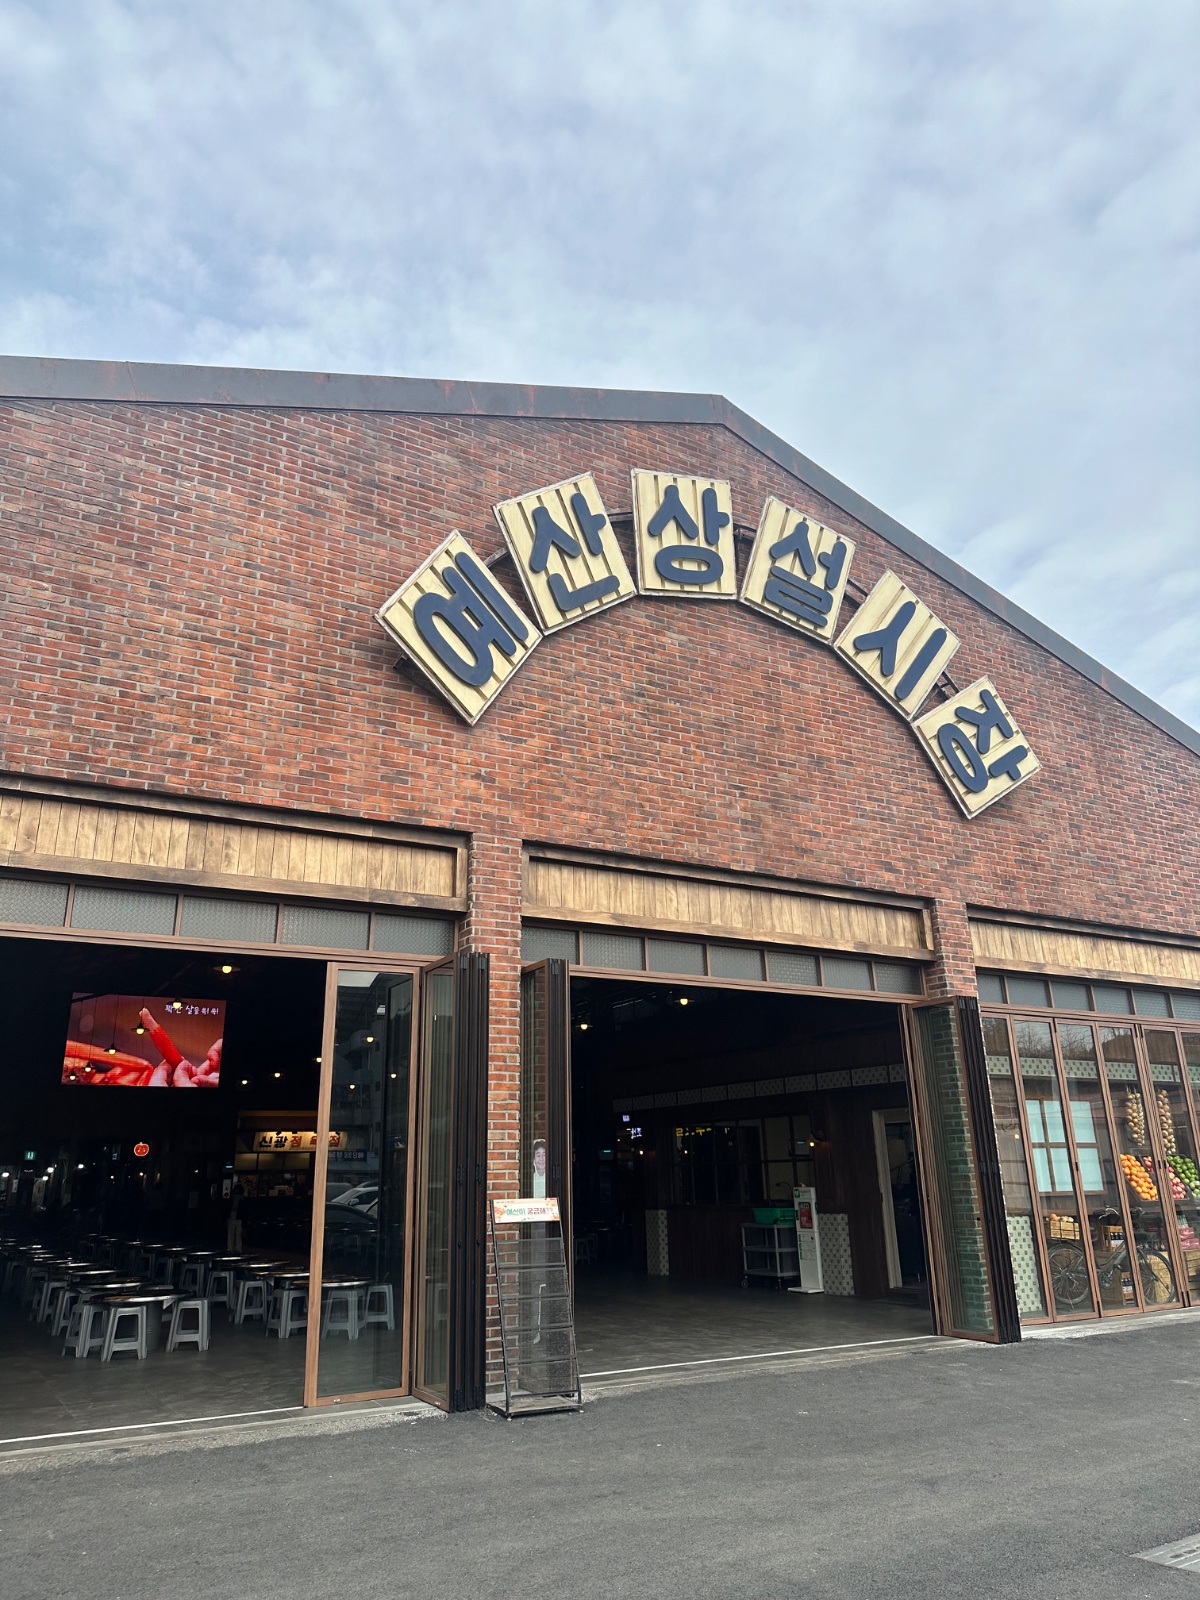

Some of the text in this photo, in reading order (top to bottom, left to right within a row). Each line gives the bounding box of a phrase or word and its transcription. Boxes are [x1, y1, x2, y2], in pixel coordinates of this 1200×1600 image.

[413, 484, 1028, 793] 예산상설시장
[185, 1005, 200, 1015] 살을
[506, 1208, 526, 1216] 예산이
